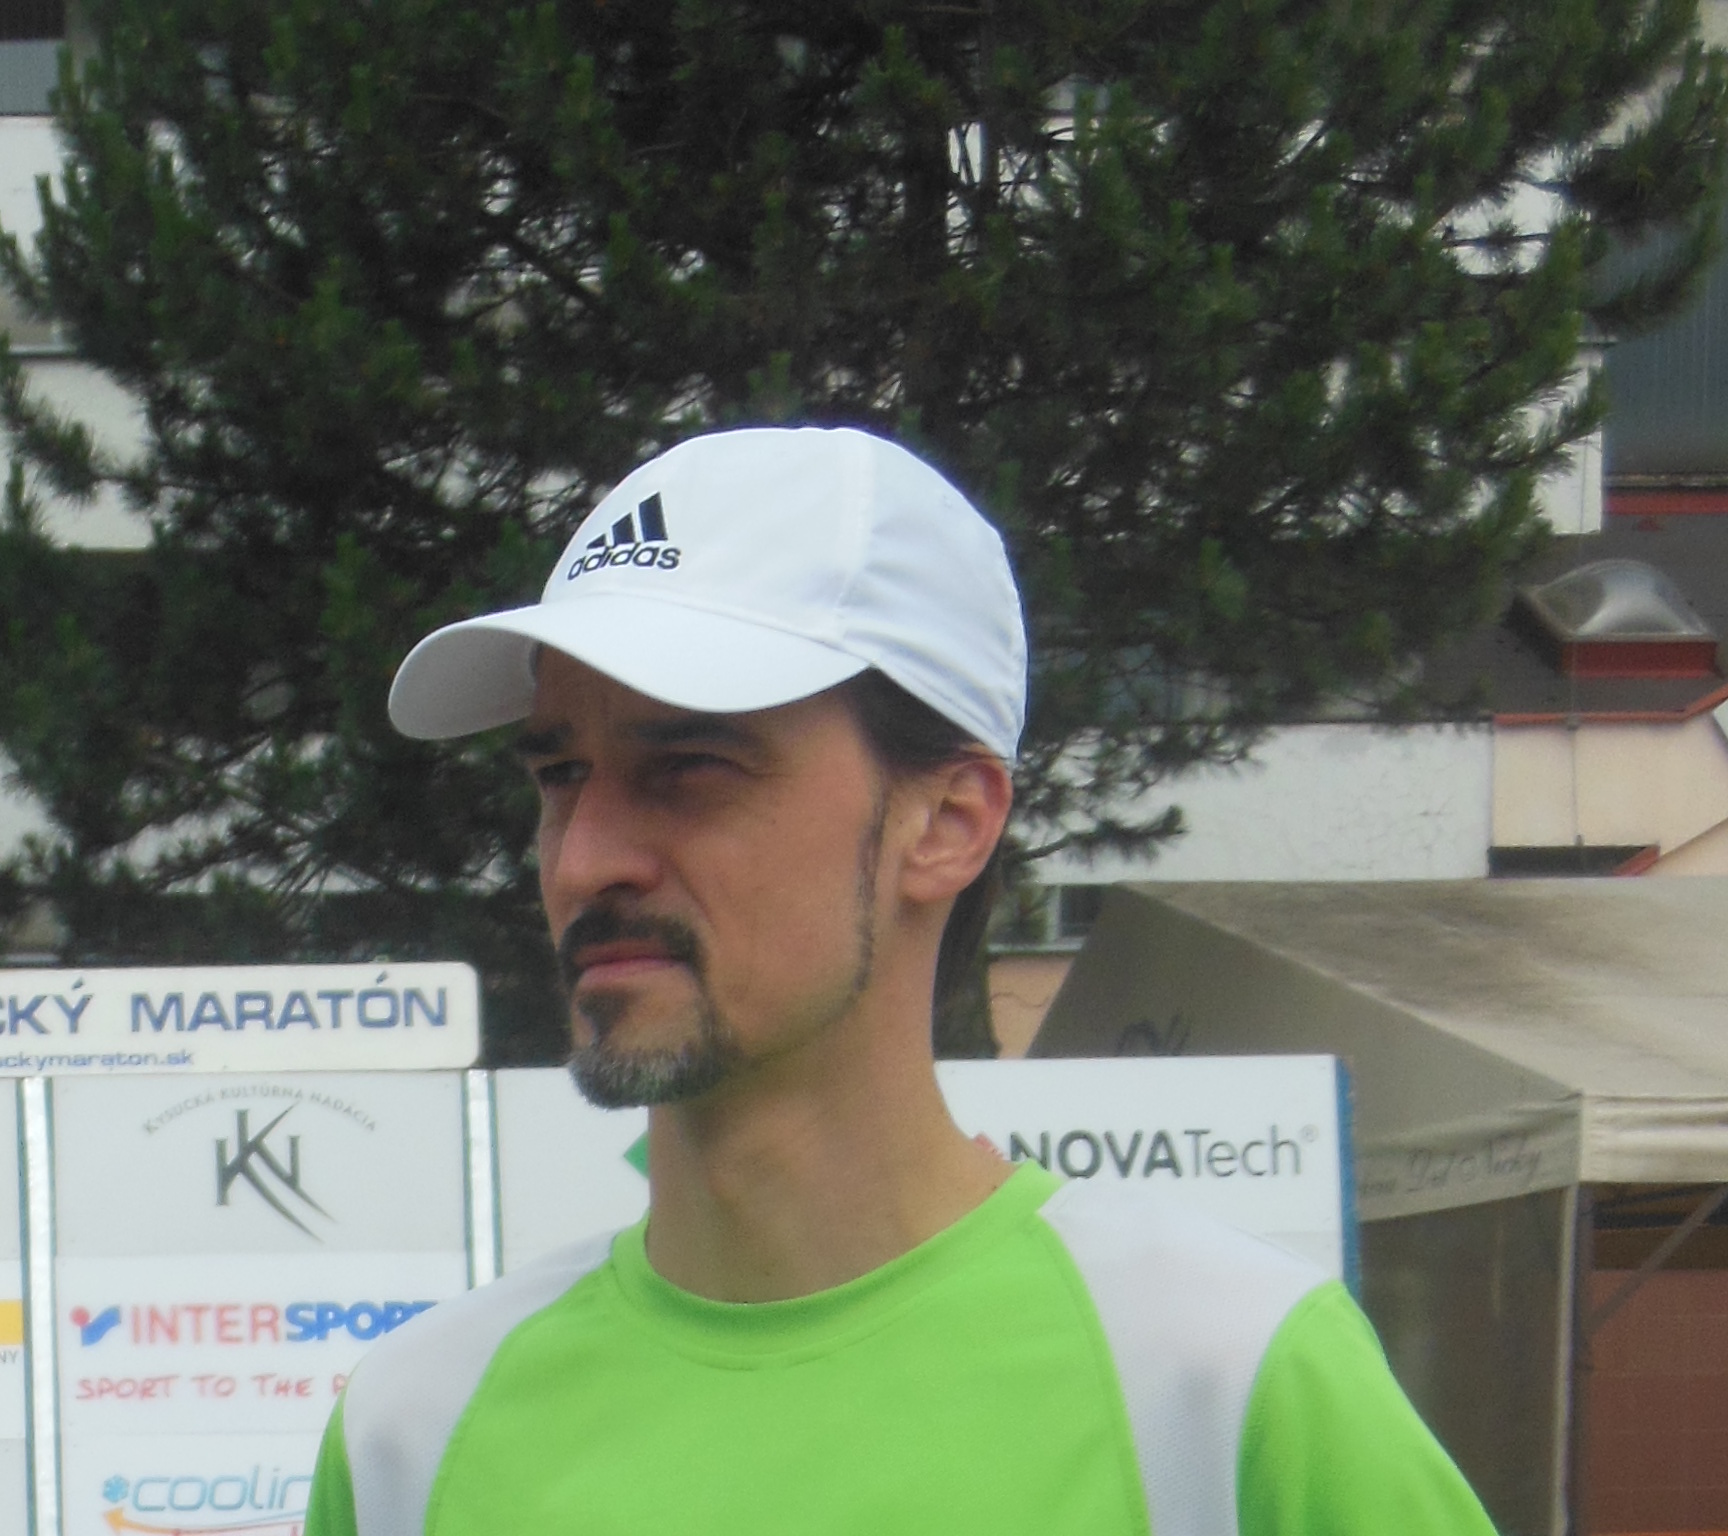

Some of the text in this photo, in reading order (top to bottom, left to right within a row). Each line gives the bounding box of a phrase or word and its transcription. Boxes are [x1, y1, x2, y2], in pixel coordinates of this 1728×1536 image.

[568, 545, 681, 580] adidas
[131, 972, 447, 1032] MARATÓN
[1009, 1124, 1301, 1179] NOVATech
[132, 1300, 438, 1343] INTERSPOR
[76, 1373, 179, 1400] SPORT
[190, 1373, 236, 1398] TO
[132, 1464, 314, 1512] coolin
